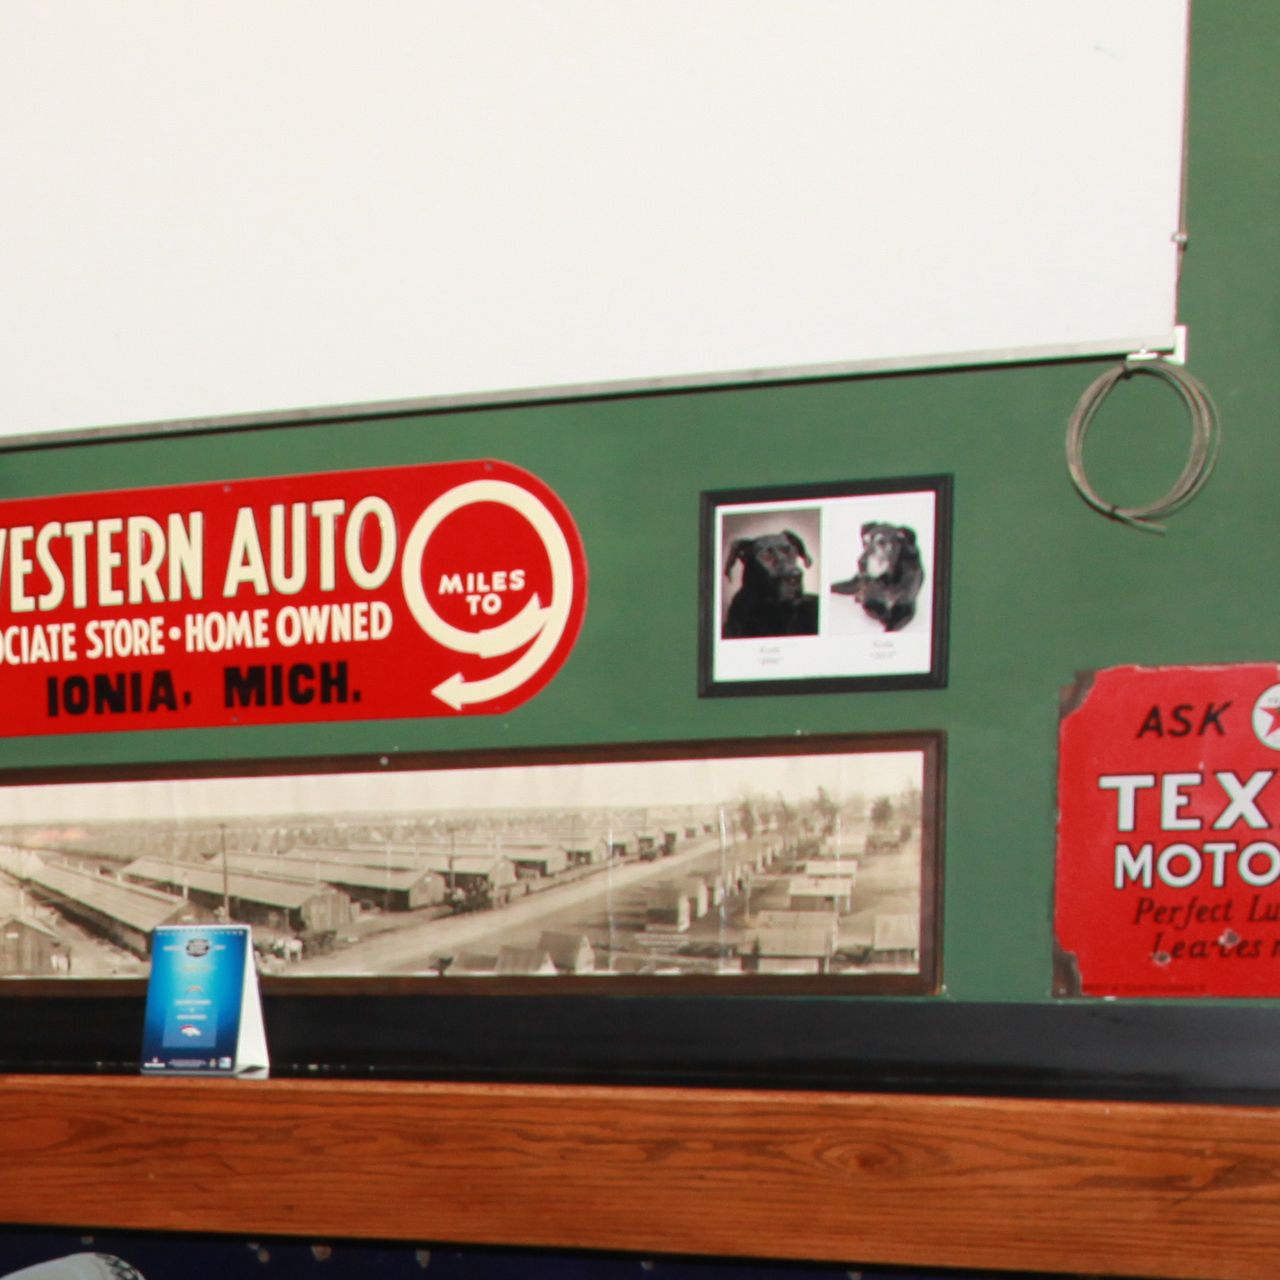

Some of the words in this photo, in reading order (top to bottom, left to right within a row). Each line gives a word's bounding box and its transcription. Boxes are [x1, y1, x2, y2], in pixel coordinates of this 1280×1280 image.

[222, 495, 397, 599] AUTO
[438, 568, 526, 595] MILES
[465, 592, 503, 616] TO
[85, 616, 165, 660] STORE
[184, 608, 270, 654] HOME
[275, 600, 394, 648] OWNED
[223, 660, 362, 708] MICH.
[1136, 700, 1233, 739] ASK
[1097, 768, 1278, 833] TEX
[1113, 840, 1280, 890] MOTO
[1132, 895, 1234, 931] Perfect
